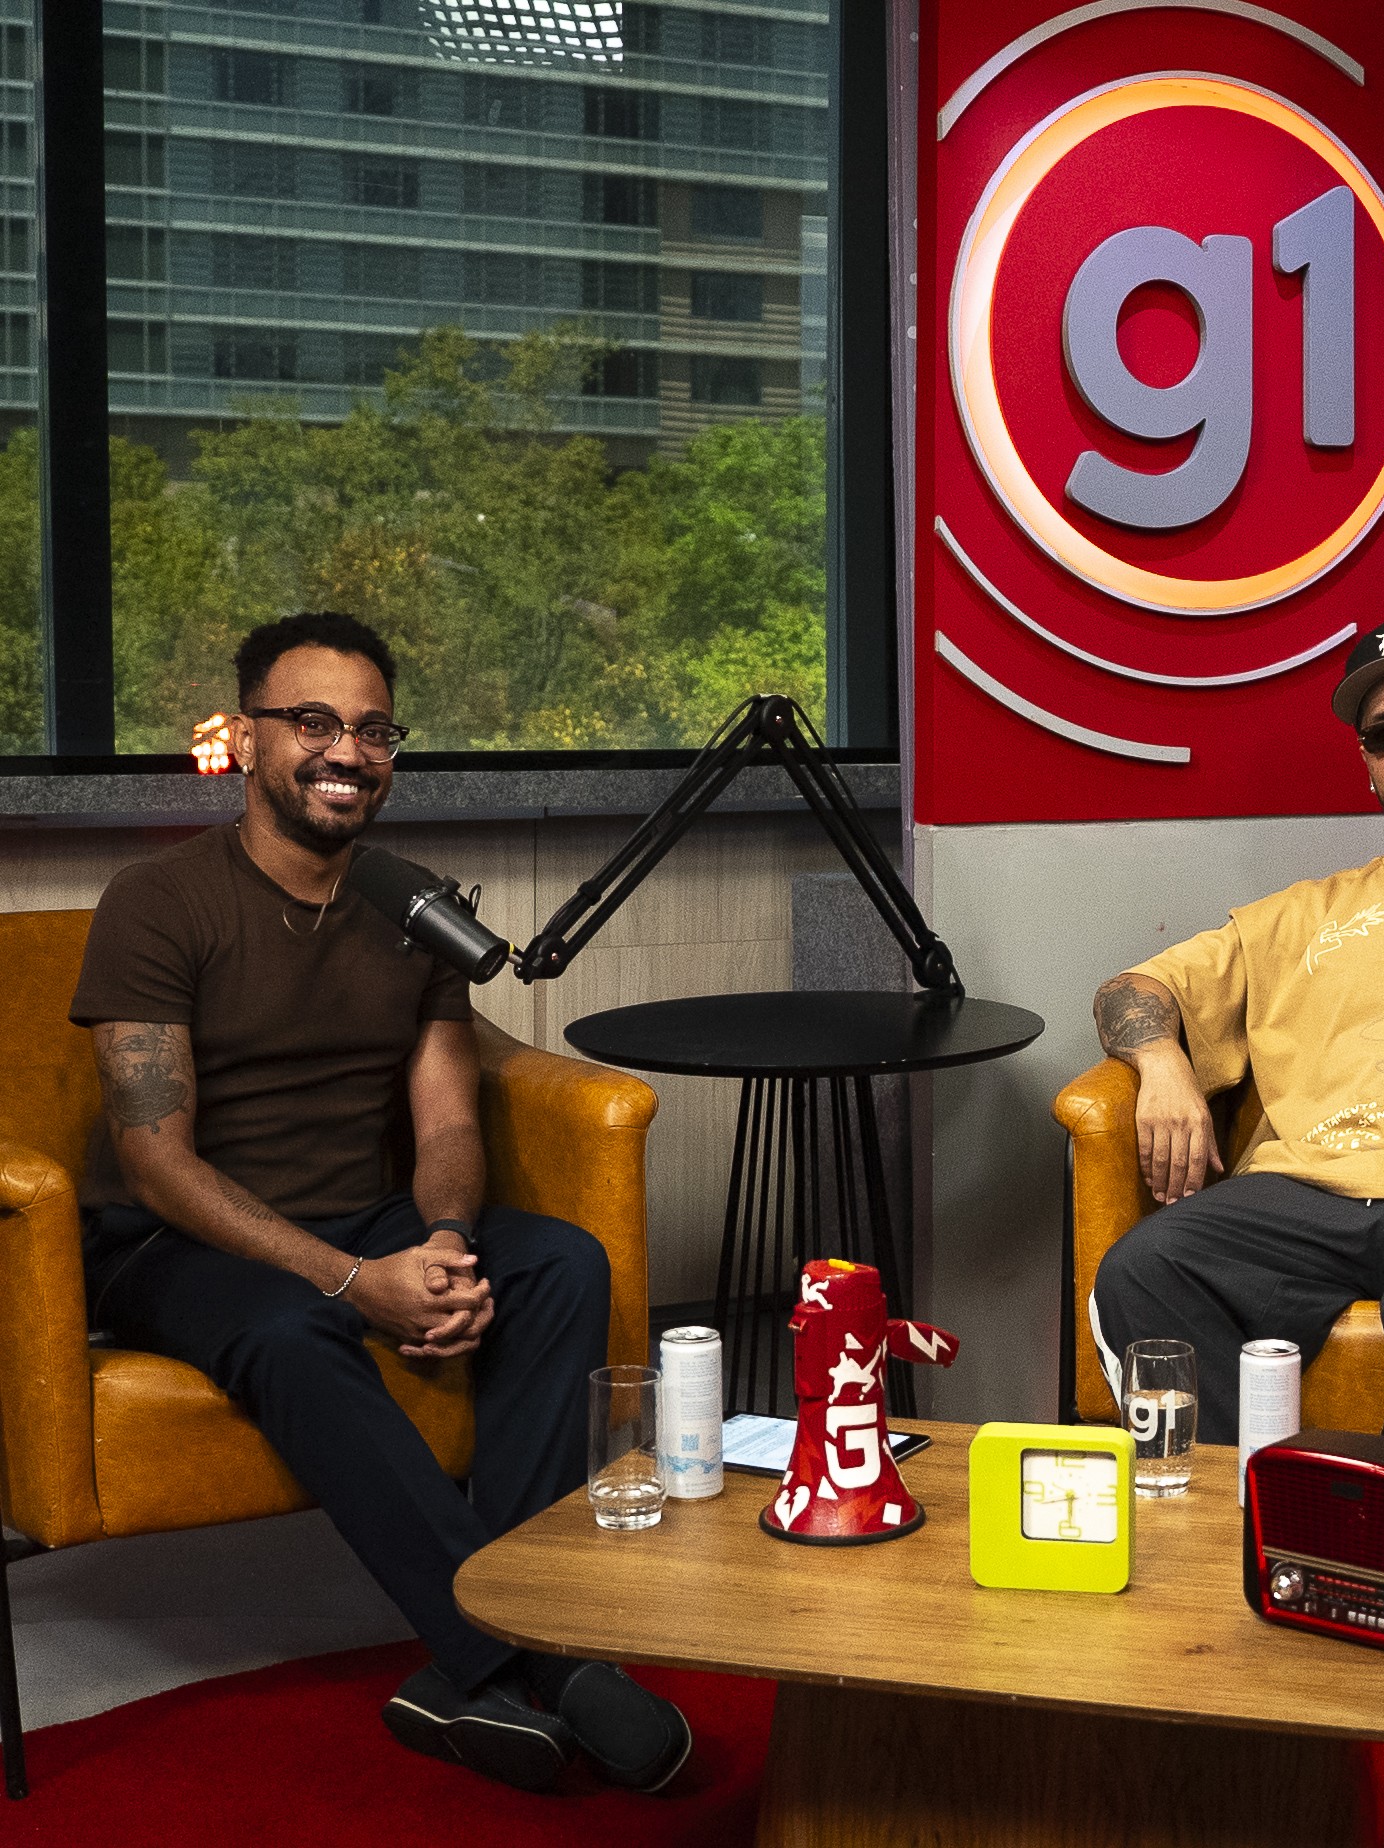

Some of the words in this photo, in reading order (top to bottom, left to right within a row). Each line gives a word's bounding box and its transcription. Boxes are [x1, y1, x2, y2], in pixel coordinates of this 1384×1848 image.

[1062, 185, 1355, 529] g1
[825, 1403, 882, 1490] G
[1128, 1389, 1176, 1442] g1
